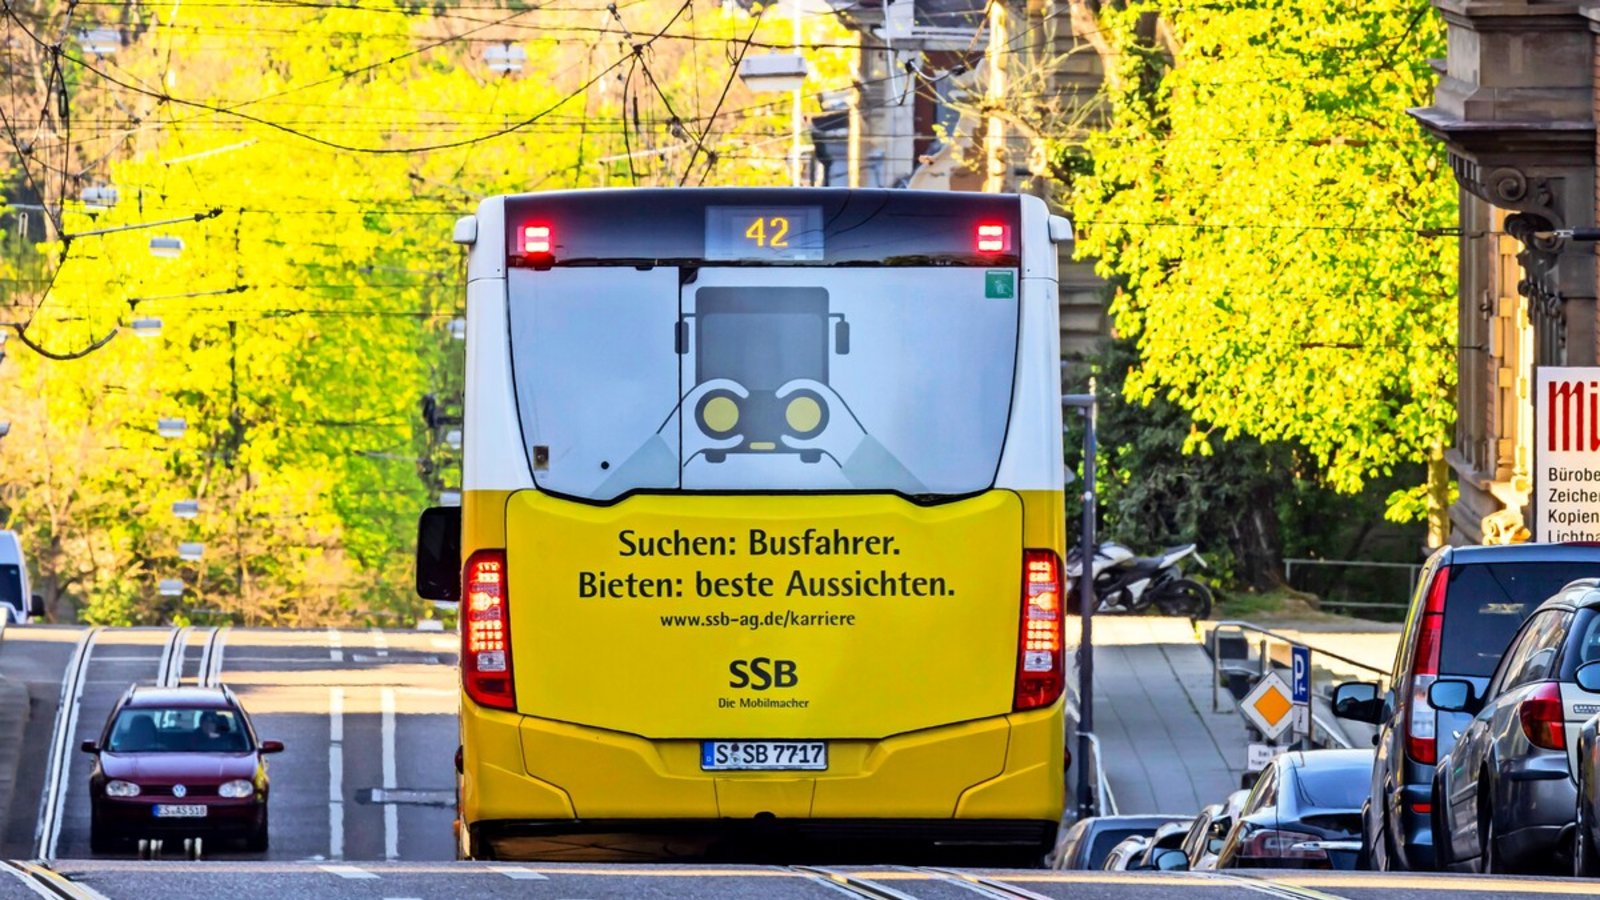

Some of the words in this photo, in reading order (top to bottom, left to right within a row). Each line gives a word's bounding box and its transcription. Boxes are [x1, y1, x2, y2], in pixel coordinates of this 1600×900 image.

[745, 217, 789, 247] 42
[1548, 488, 1600, 503] Zeiche
[1548, 509, 1600, 526] Kopien
[618, 529, 736, 557] Suchen:
[749, 528, 900, 556] Busfahrer.
[579, 571, 683, 598] Bieten:
[695, 570, 774, 598] beste
[785, 569, 955, 597] Aussichten.
[660, 610, 856, 630] www.ssb-ag.de/karriere
[729, 657, 798, 691] SSB
[1294, 654, 1305, 695] P
[718, 698, 736, 709] Die
[740, 697, 809, 709] Mobilmacher
[743, 744, 768, 764] SB
[773, 744, 824, 763] 7717
